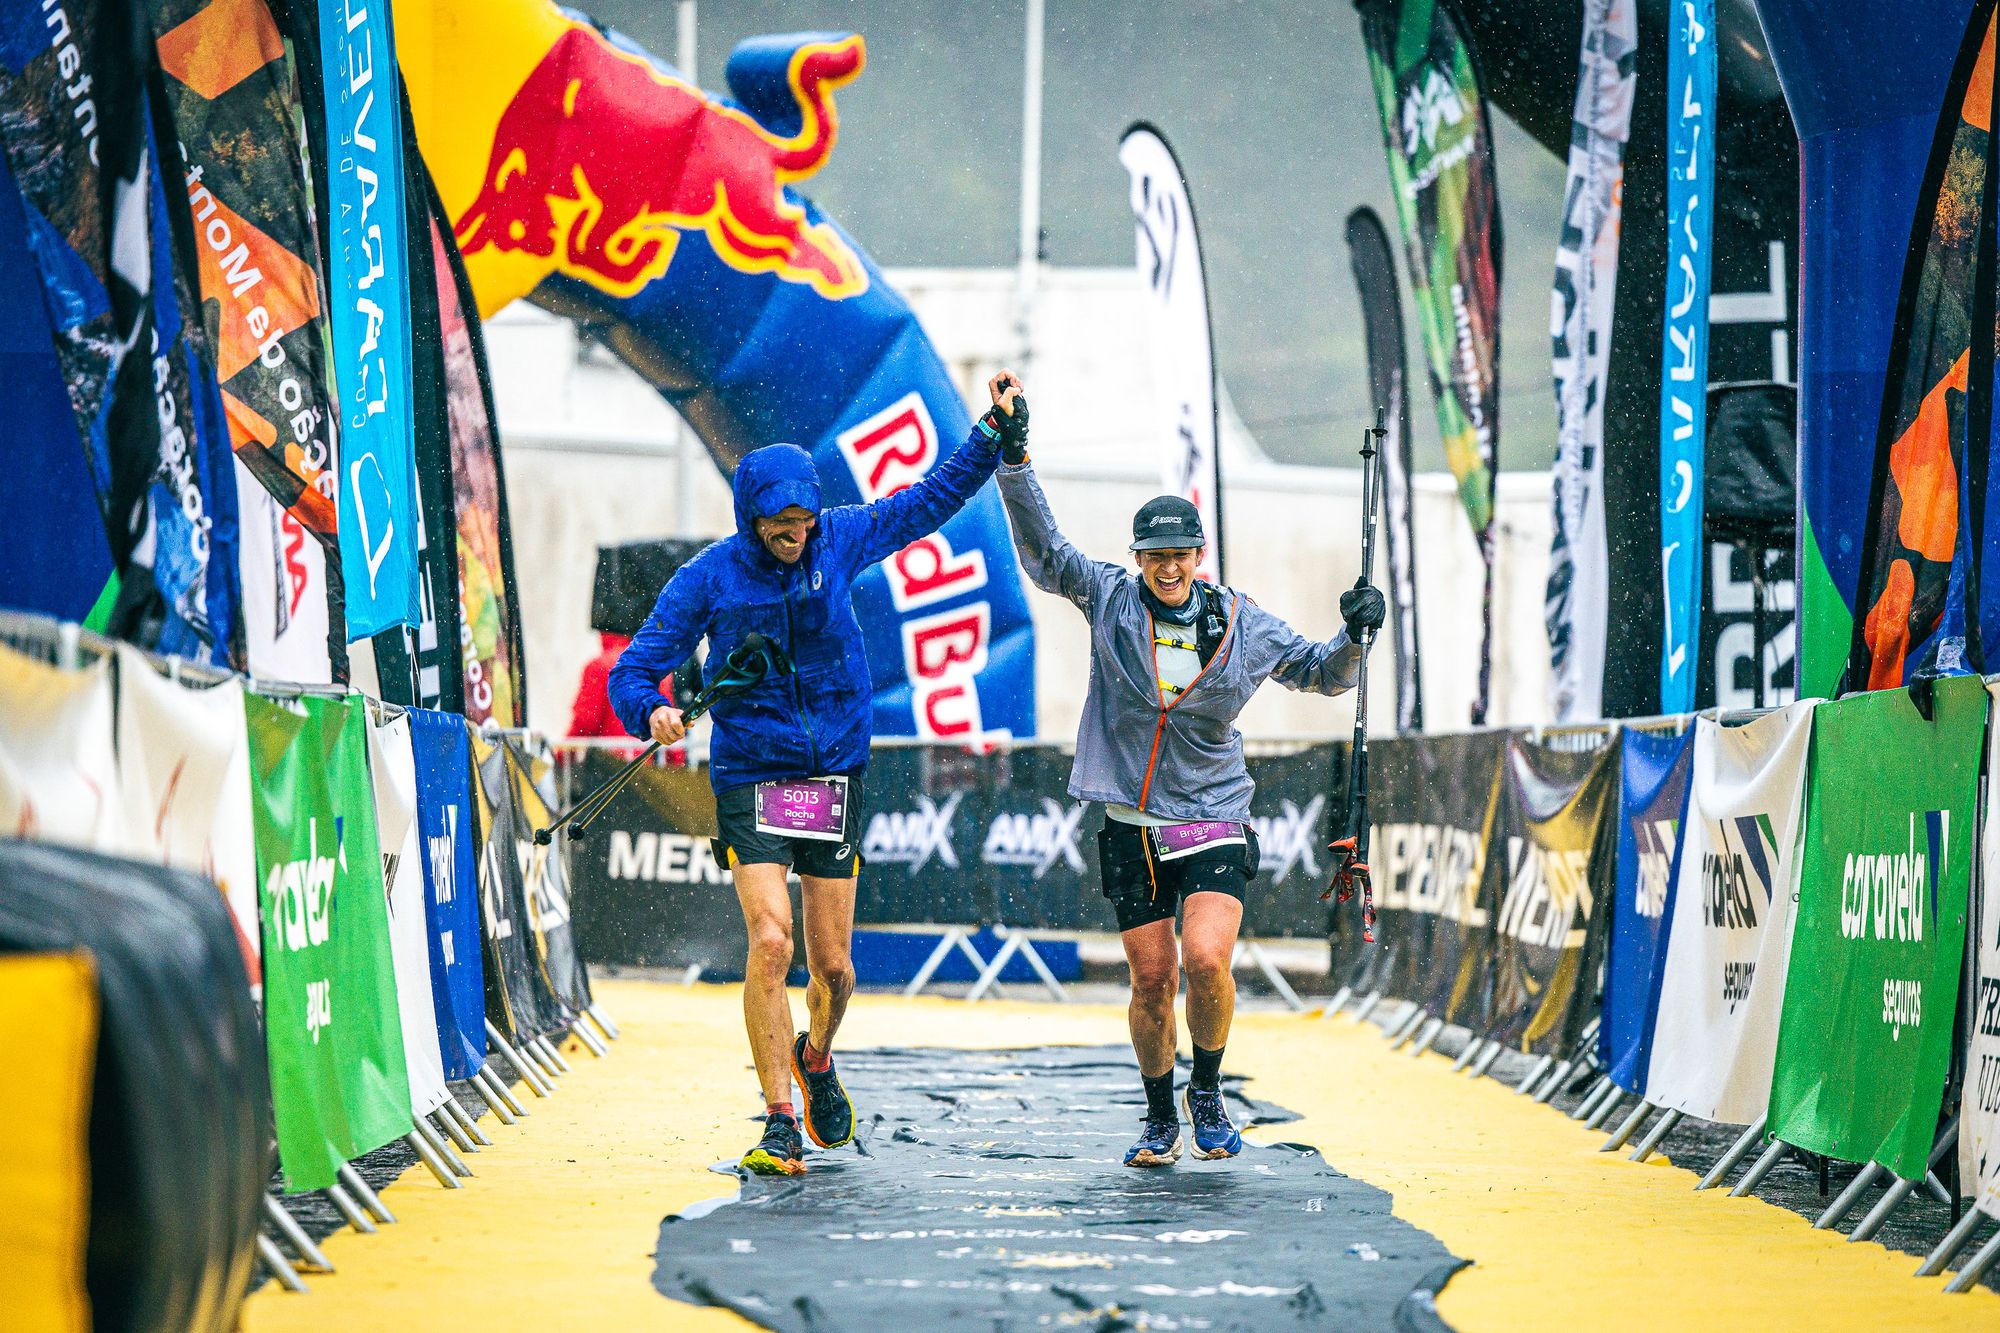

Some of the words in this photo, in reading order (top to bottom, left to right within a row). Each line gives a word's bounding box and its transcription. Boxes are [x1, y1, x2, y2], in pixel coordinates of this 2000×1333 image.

[841, 396, 986, 608] Rd
[783, 789, 819, 805] 5013
[784, 808, 816, 820] Rocha
[1179, 821, 1219, 838] Brugger
[1840, 811, 1925, 943] caravela
[1882, 977, 1922, 1042] seguros
